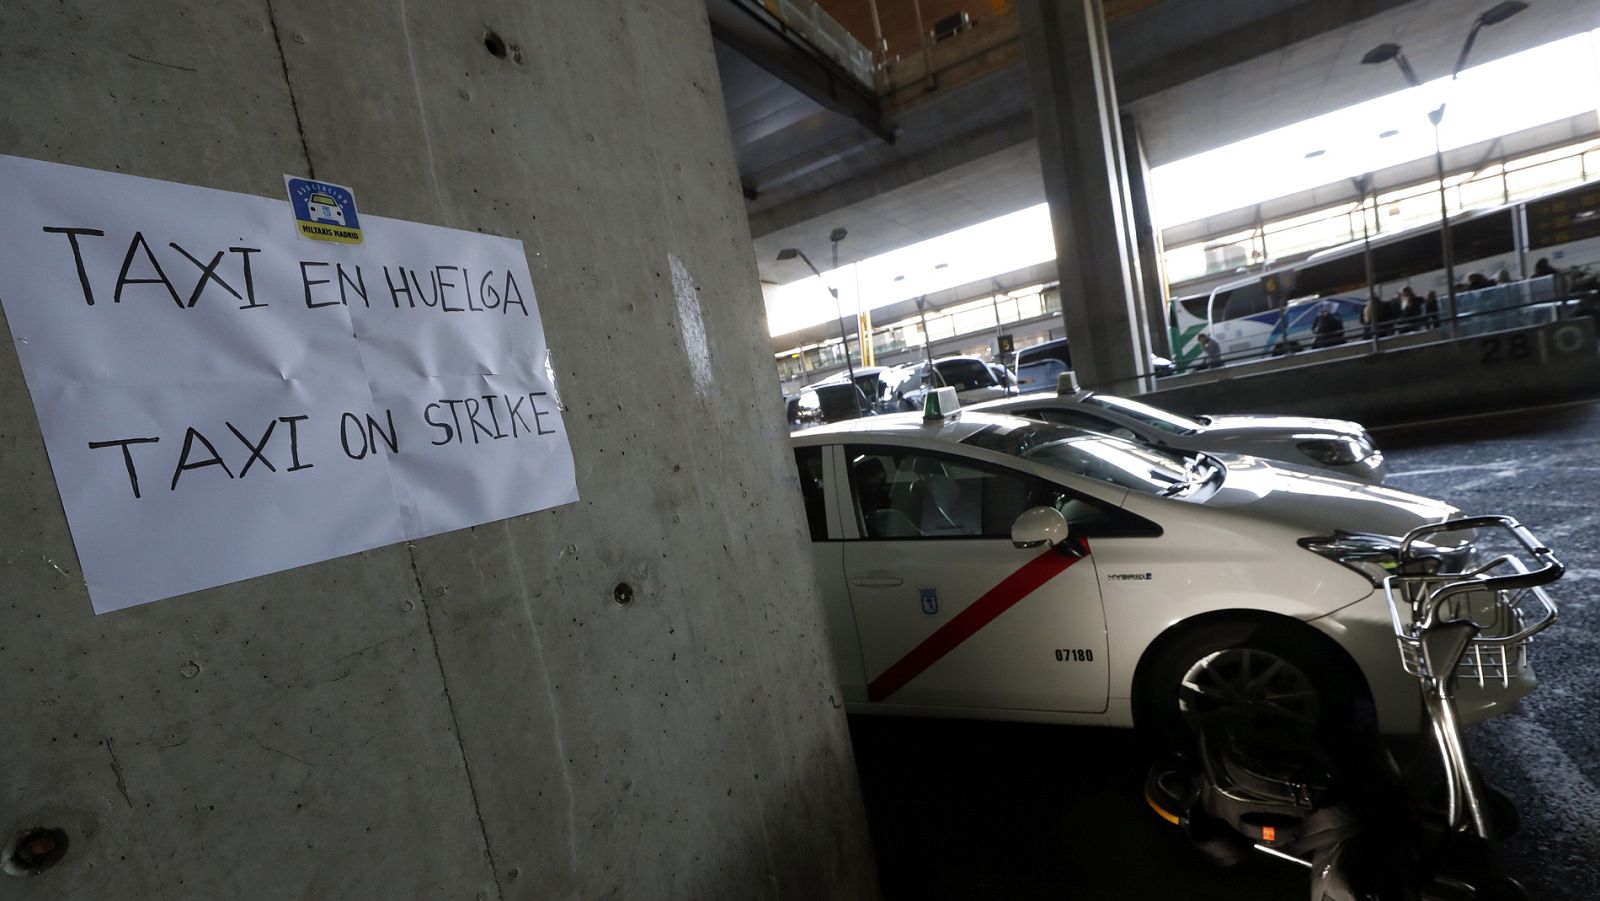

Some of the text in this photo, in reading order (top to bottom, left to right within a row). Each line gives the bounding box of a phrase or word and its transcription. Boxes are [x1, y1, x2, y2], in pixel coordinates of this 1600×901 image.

[302, 225, 359, 240] MILTAXIS MADRID
[43, 226, 529, 316] TAXI EN HUELGA
[89, 391, 557, 499] TAXI ON STRIKE
[1055, 648, 1094, 662] 07180
